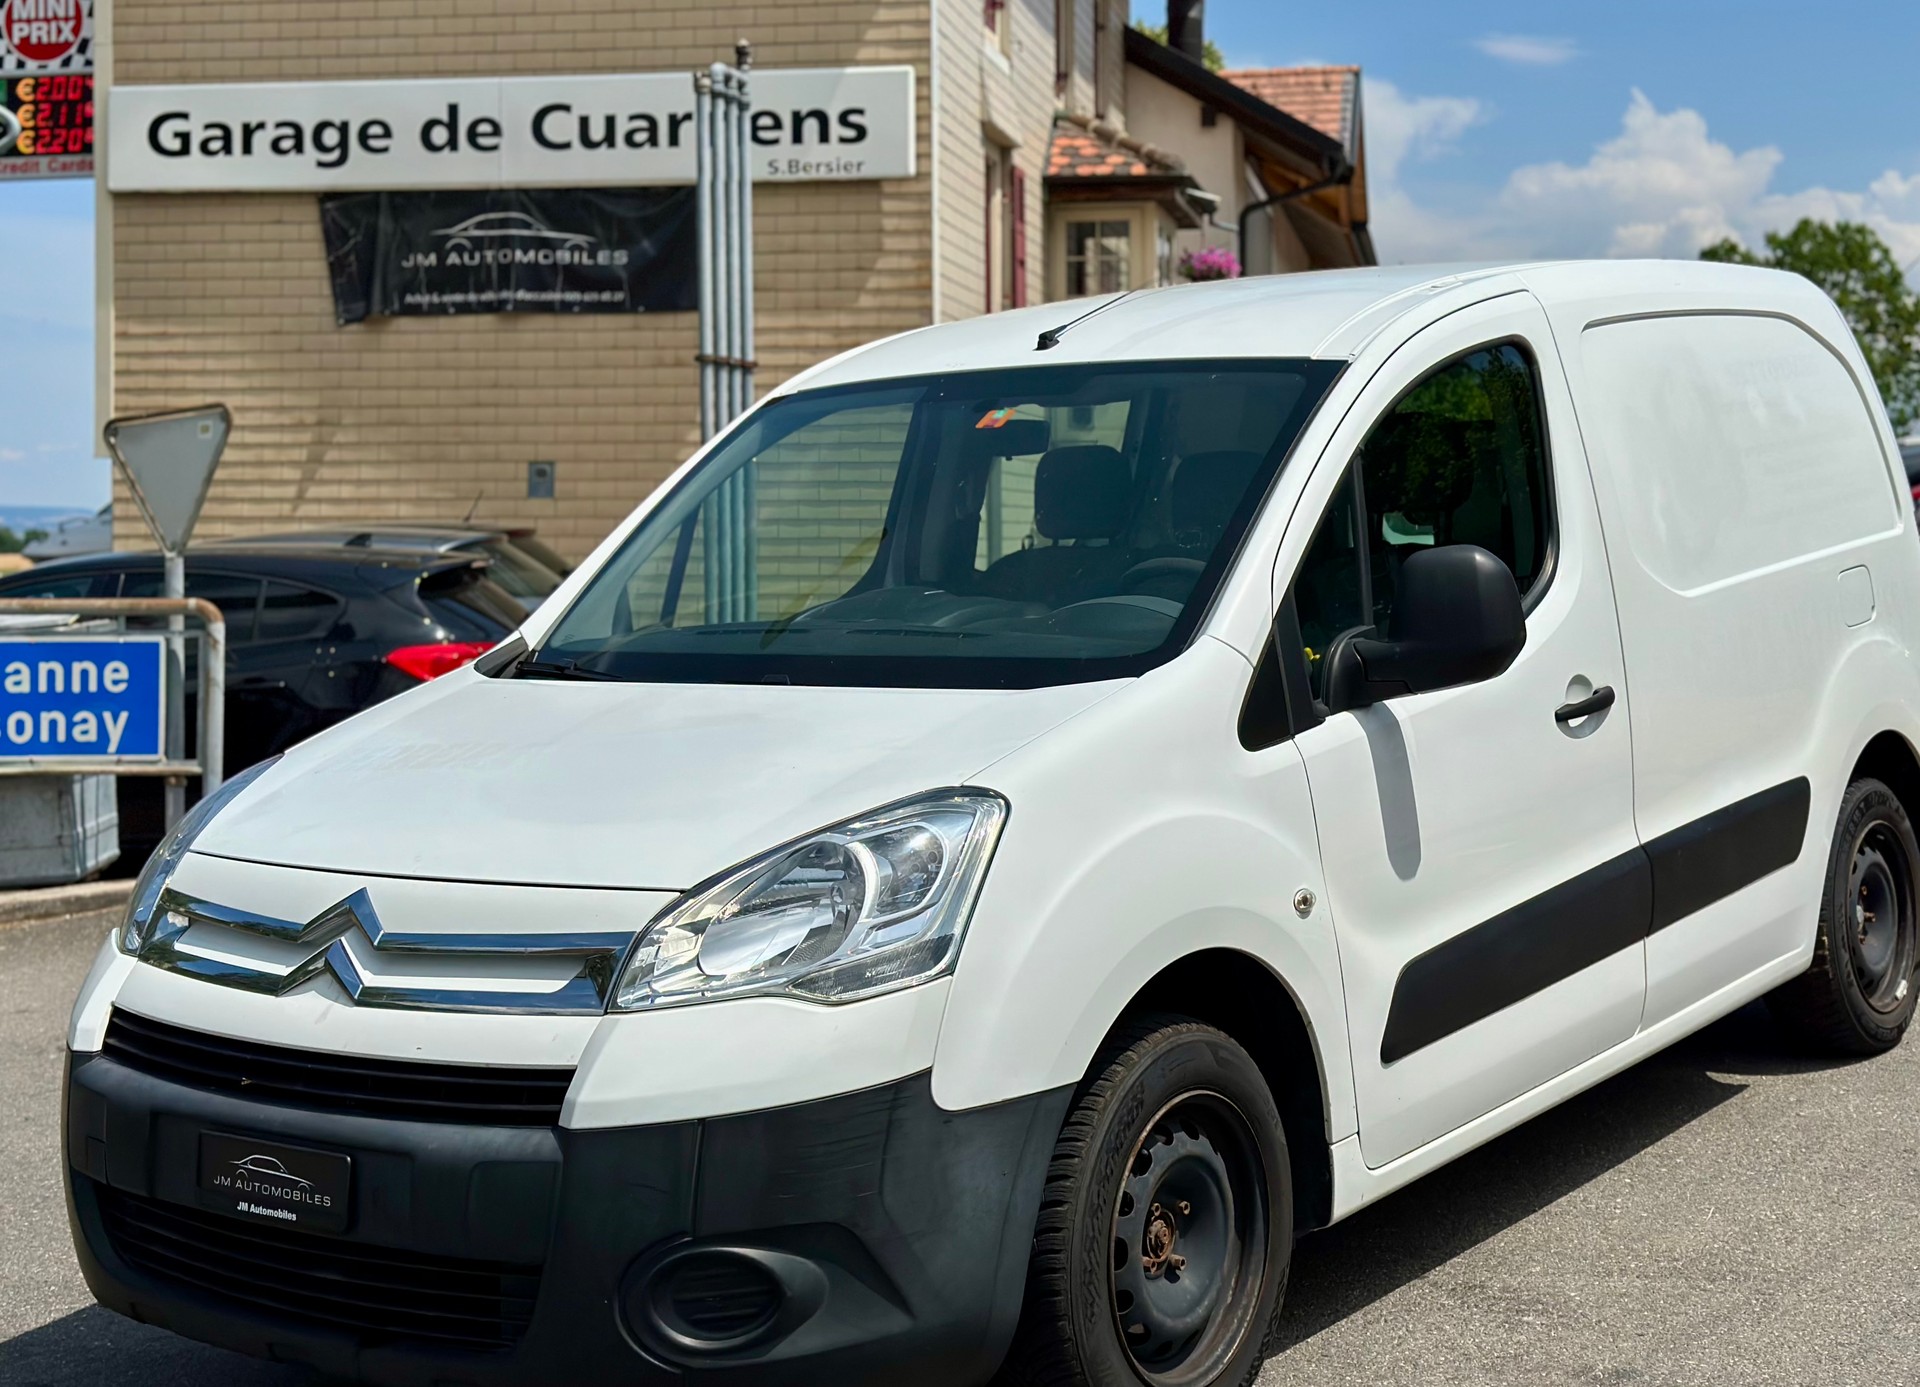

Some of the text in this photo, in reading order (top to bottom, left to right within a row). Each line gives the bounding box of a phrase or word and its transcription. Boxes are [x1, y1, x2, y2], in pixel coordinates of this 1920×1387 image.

[11, 0, 76, 20] MINI
[11, 20, 77, 46] PRIX
[147, 102, 868, 169] Garage de Cuarens
[0, 159, 40, 174] redit
[401, 249, 629, 268] JM AUTOMOBILES
[0, 710, 130, 754] onay
[213, 1176, 331, 1207] JM AUTOMOBILES
[237, 1201, 297, 1221] JM Automobiles
